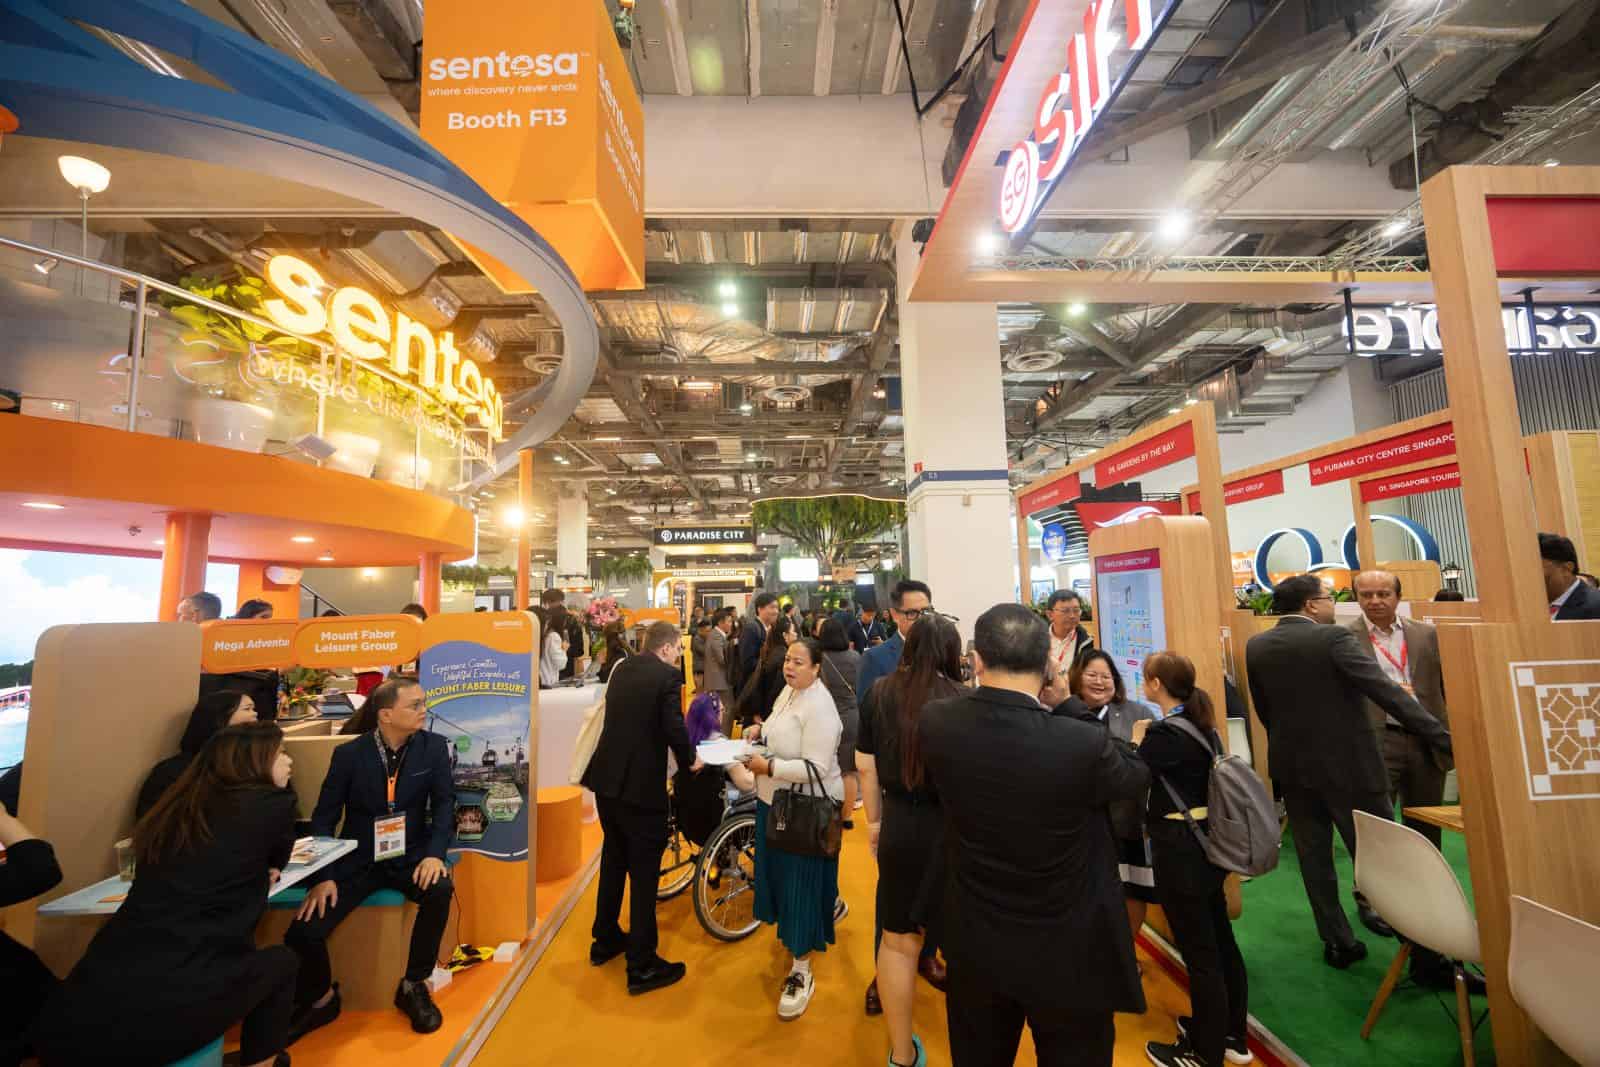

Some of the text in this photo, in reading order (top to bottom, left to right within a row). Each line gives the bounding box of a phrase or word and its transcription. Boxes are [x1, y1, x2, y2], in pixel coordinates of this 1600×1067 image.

[428, 50, 579, 81] sentosa
[428, 81, 577, 97] where discovery never ends
[447, 107, 568, 130] Booth F13
[262, 255, 503, 442] sentosa
[1140, 452, 1150, 463] BY
[1150, 447, 1162, 459] THE
[1162, 440, 1176, 454] BAY
[1324, 459, 1356, 473] FURAMA
[1356, 453, 1375, 465] CITY
[1375, 444, 1411, 459] CENTRE
[1389, 477, 1430, 491] SINGAPORE
[674, 530, 745, 540] PARADISE CITY
[320, 629, 396, 641] Mount Faber
[214, 639, 244, 652] Mega
[314, 641, 398, 654] Leisure Group
[426, 681, 528, 698] MOUNT FABER LEISURE
